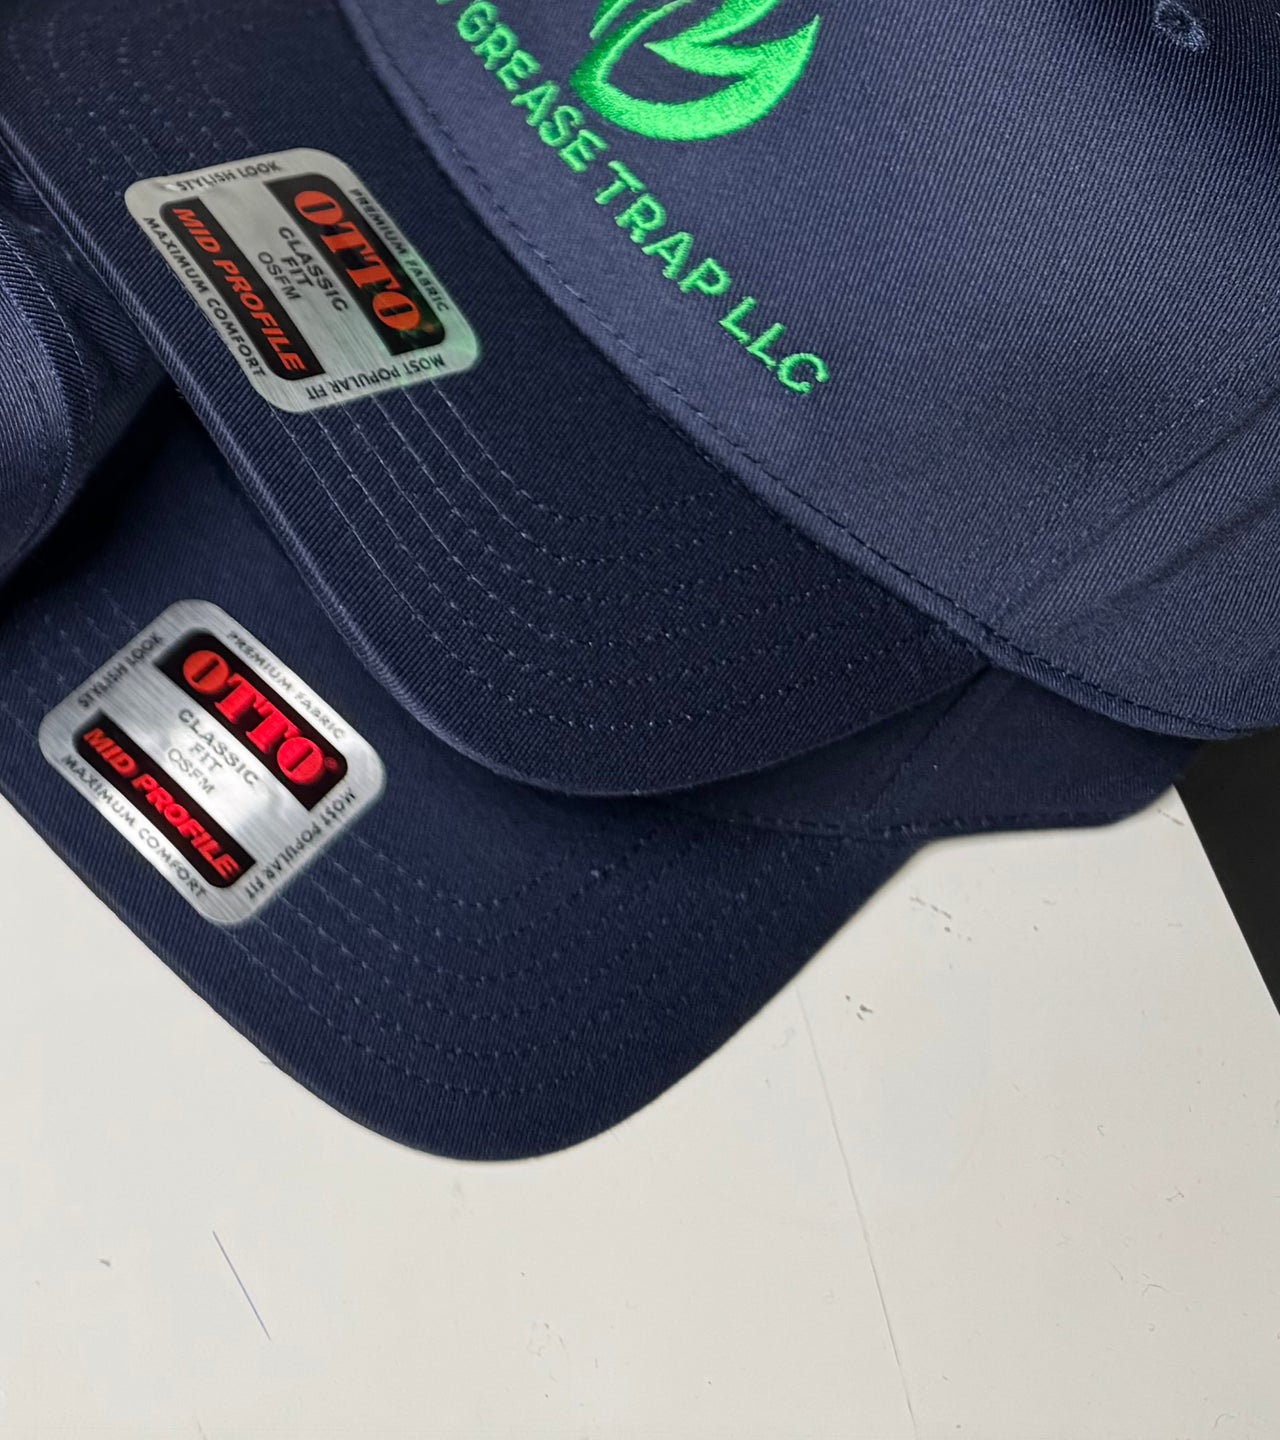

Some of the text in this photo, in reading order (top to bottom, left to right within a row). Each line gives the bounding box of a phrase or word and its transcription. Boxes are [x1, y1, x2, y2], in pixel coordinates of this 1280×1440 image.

[176, 160, 282, 193] STYLISH LOOK
[143, 215, 267, 378] MAXIMUM COMFORT
[172, 207, 308, 372] MID PROFILE
[256, 249, 302, 301] OSFM
[278, 225, 350, 313] CLASSIC
[280, 255, 315, 289] FIT
[293, 190, 422, 331] OTTO
[348, 187, 450, 313] PREMIUM FABRIC
[594, 160, 733, 297] TRAP
[718, 295, 830, 395] LLC
[306, 352, 447, 401] MOST POPULAR FIT
[76, 632, 165, 710] STYLISH LOOK
[182, 649, 325, 785] OTTO
[224, 630, 349, 742] PREMIUM FABRIC
[166, 746, 216, 796] OSFM
[177, 707, 260, 787] CLASSIC
[189, 742, 224, 775] FIT
[62, 753, 208, 899] MAXIMUM COMFORT
[83, 727, 242, 881] MID PROFILE
[242, 789, 357, 900] MOST POPULAR FIT
